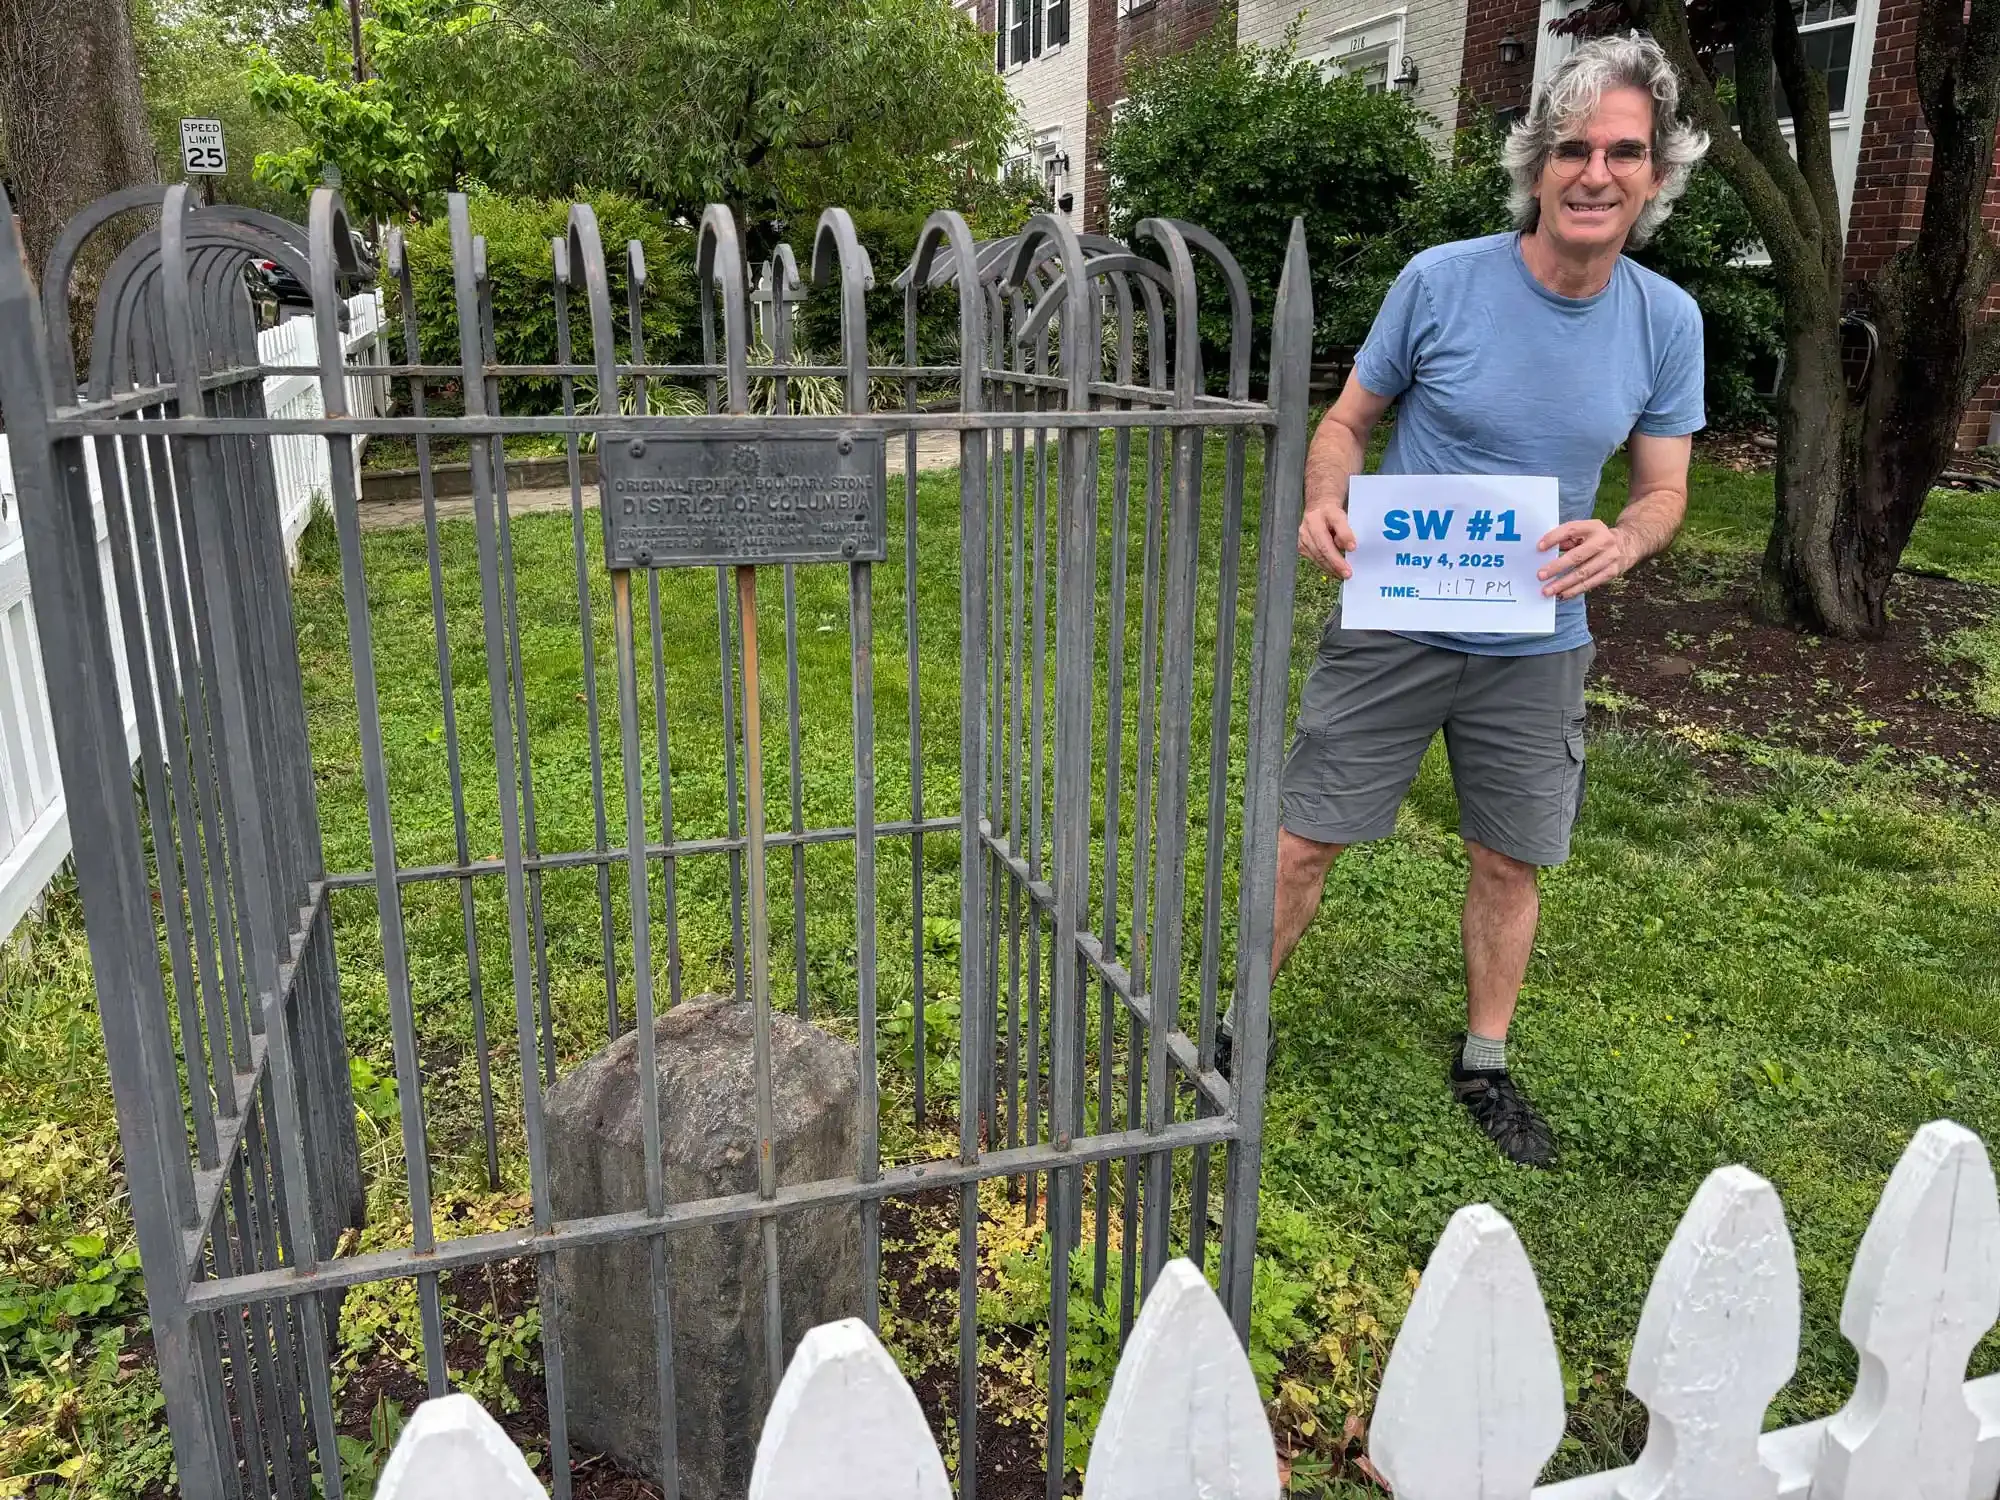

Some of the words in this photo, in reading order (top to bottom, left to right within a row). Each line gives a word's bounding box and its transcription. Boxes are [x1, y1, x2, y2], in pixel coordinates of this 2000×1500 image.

[1350, 36, 1366, 52] 1218
[184, 123, 220, 133] SPEED
[189, 135, 217, 144] LIMIT
[187, 147, 224, 168] 25
[615, 478, 685, 493] ORIGINAL
[756, 476, 824, 492] BOUNDARY
[831, 475, 874, 490] STONE
[623, 494, 728, 516] DISTRICT
[733, 494, 761, 515] OF
[765, 491, 873, 513] COLUMBIA
[820, 520, 871, 533] CHAPTER
[1382, 509, 1455, 541] SW
[1465, 509, 1522, 542] #1
[691, 537, 707, 548] OF
[712, 536, 737, 548] THE
[1395, 552, 1433, 569] May
[1437, 553, 1454, 569] 4,
[1458, 553, 1505, 568] 2025
[1380, 586, 1420, 598] TIME:
[1437, 578, 1475, 596] 1:17
[1485, 579, 1513, 597] PM
